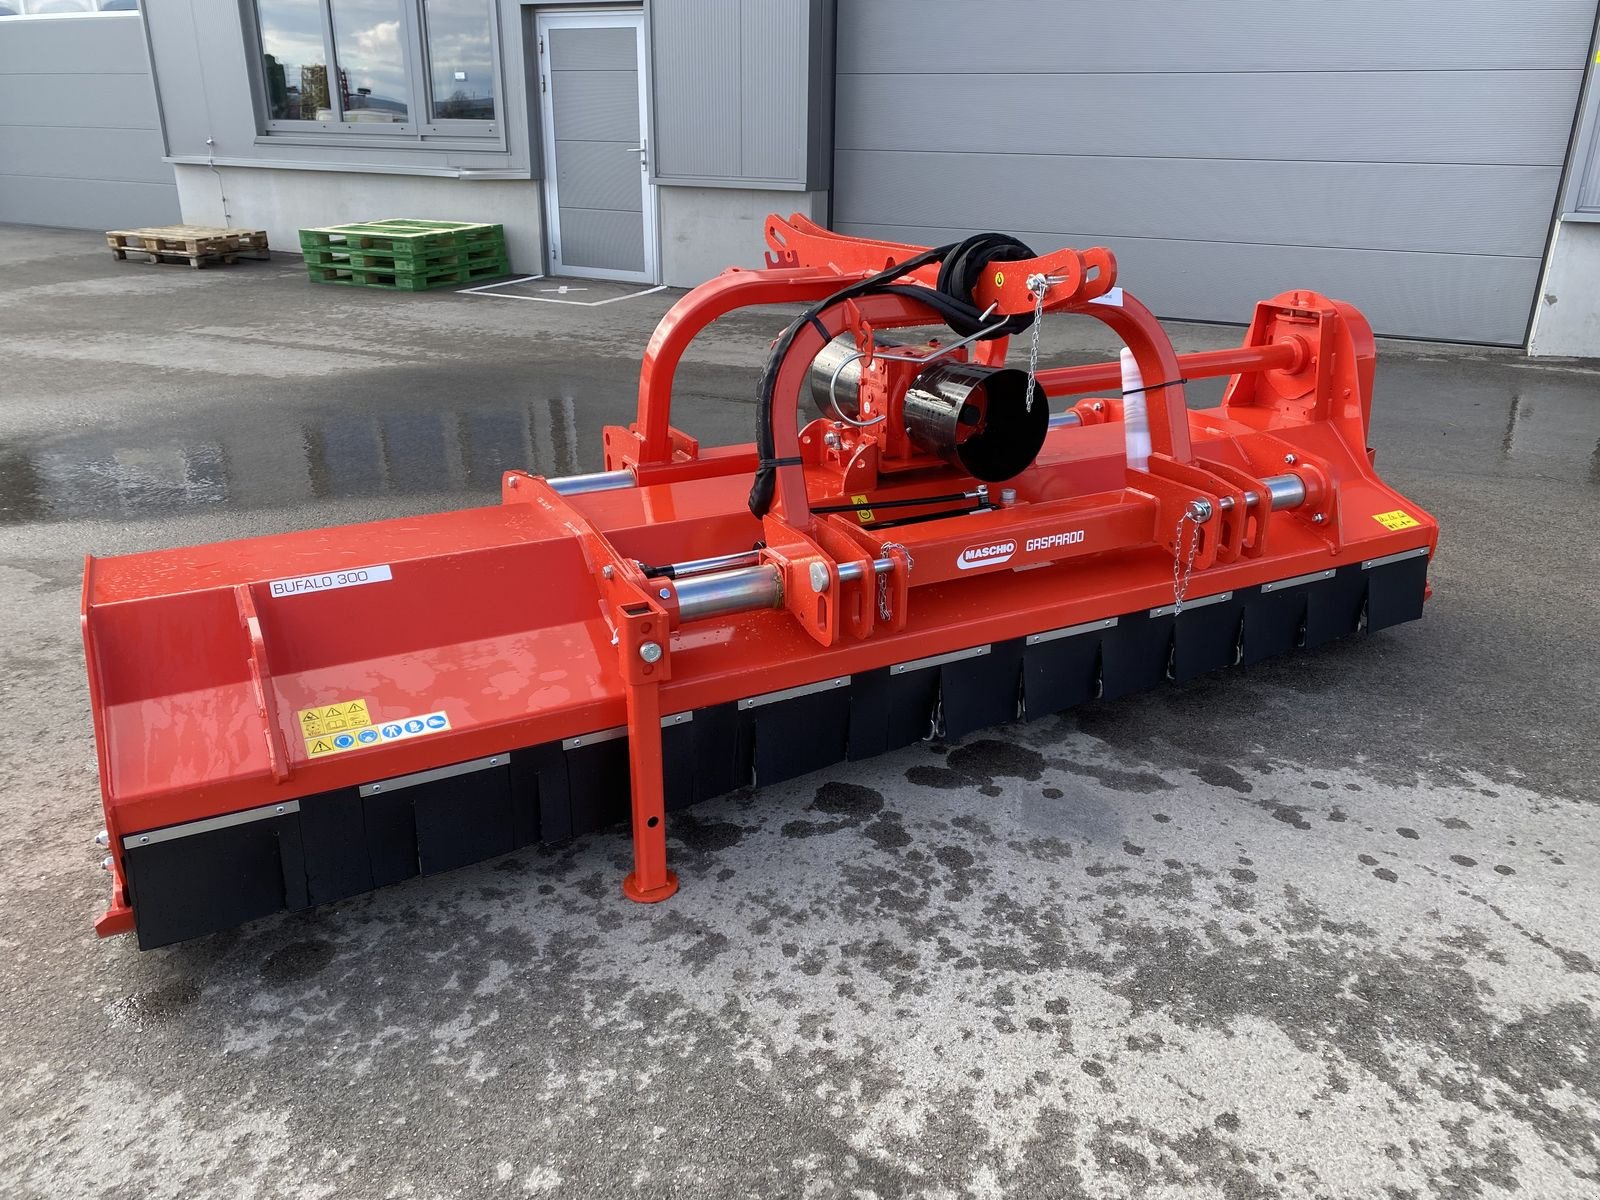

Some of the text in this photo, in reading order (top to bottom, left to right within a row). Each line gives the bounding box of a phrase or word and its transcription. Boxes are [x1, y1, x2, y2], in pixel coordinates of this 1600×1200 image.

[965, 530, 1085, 560] MASCHIO GASPARDO
[273, 571, 368, 595] BUFALO 300
